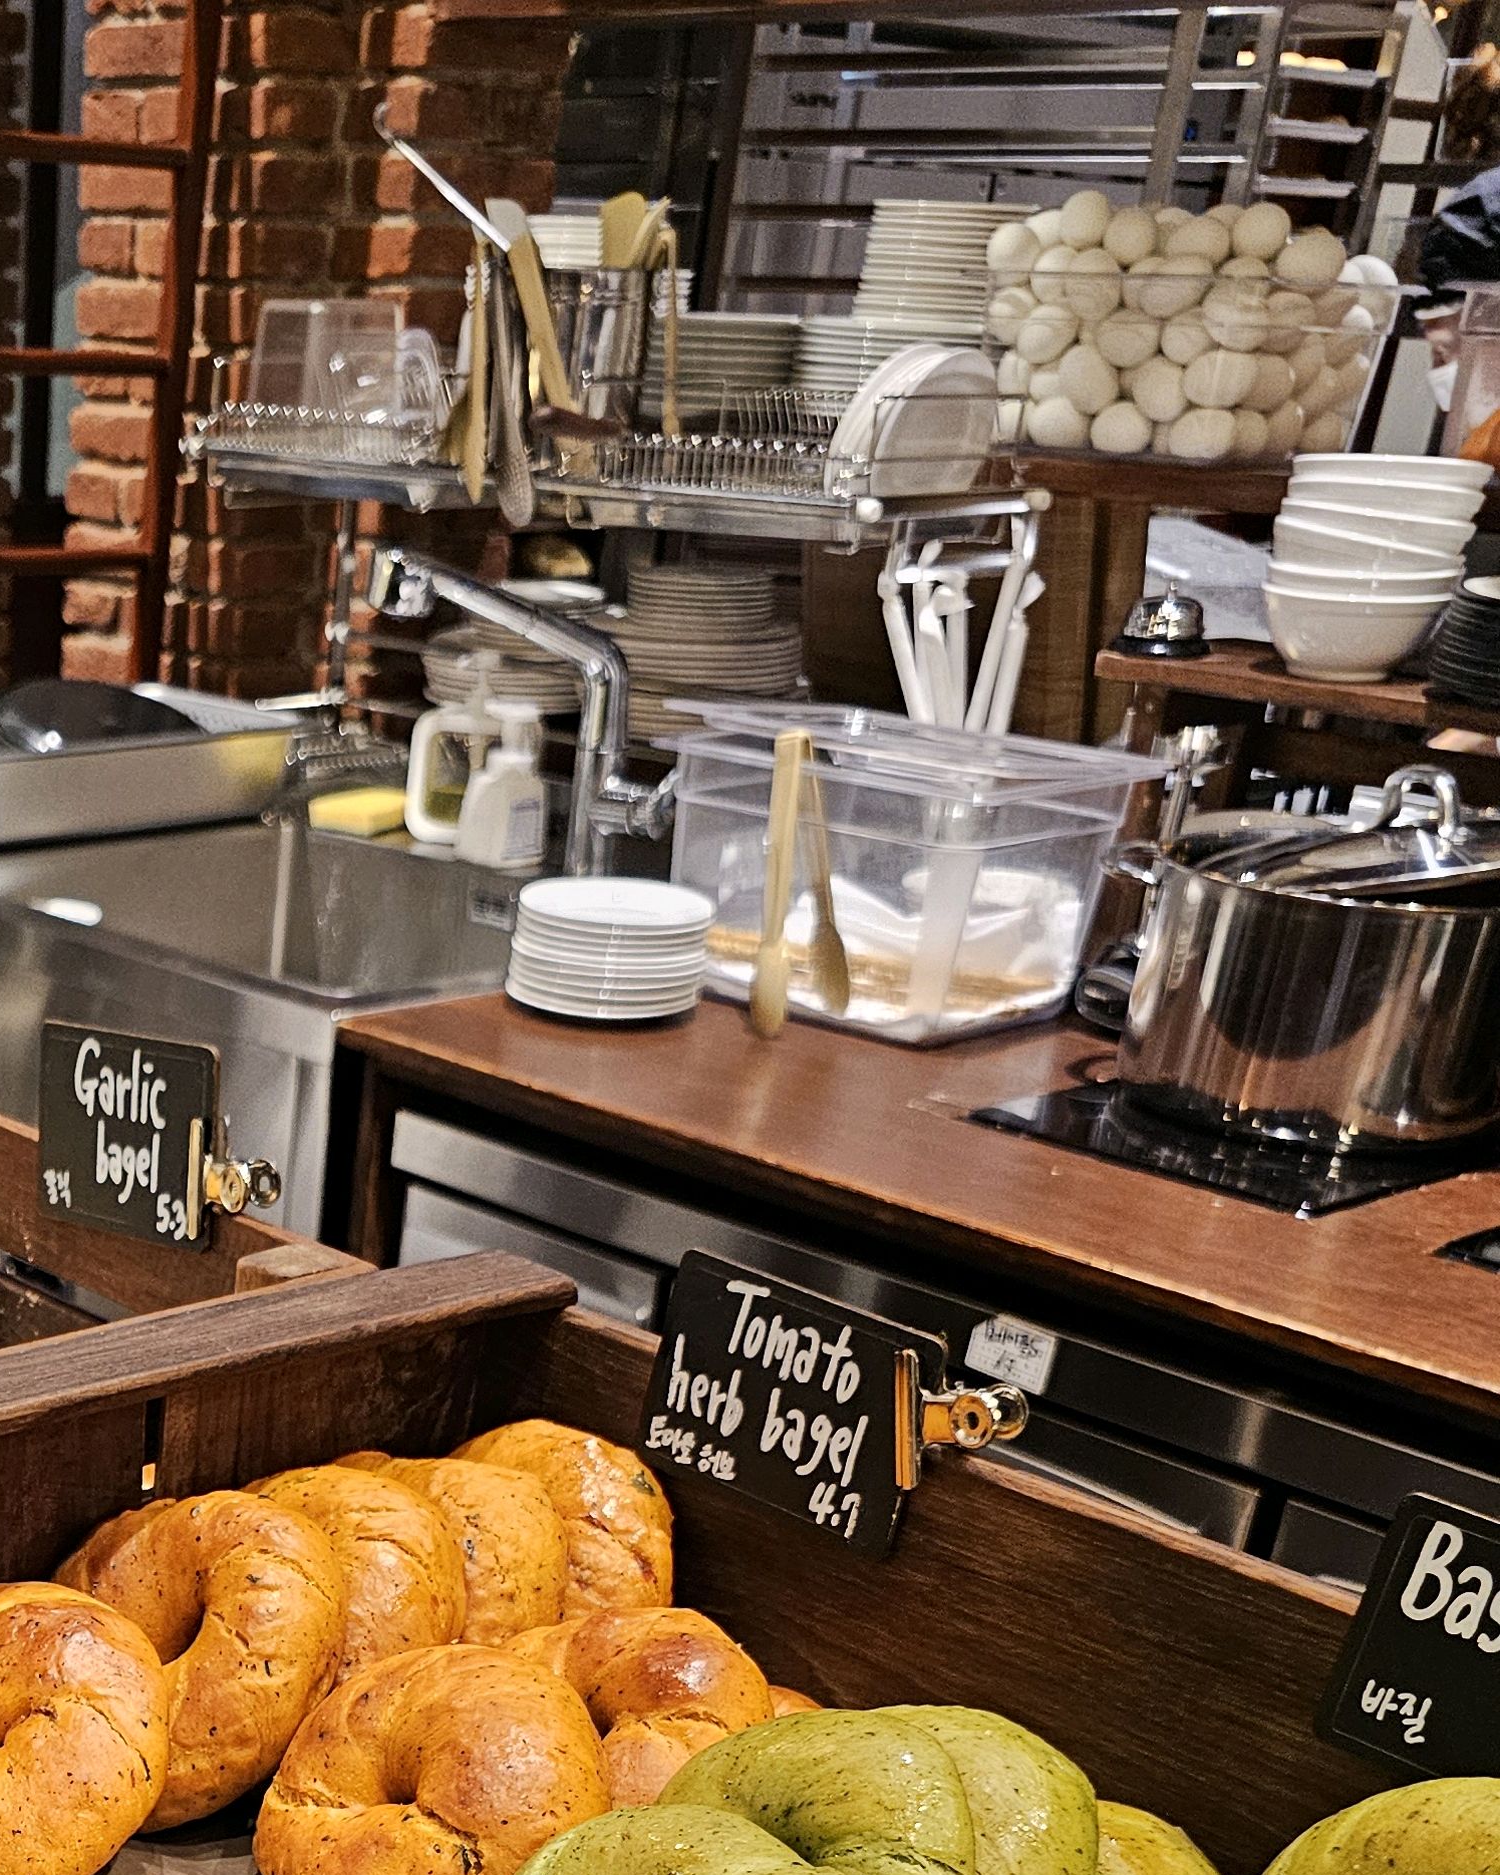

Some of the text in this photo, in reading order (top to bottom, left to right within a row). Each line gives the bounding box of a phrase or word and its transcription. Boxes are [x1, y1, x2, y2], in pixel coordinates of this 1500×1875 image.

[74, 1037, 167, 1130] Garlic
[95, 1119, 161, 1204] bagel
[725, 1279, 861, 1405] Tomato
[666, 1333, 870, 1488] herb bagel
[697, 1443, 738, 1481] 허브
[808, 1482, 861, 1539] 4.7
[1361, 1679, 1432, 1744] 바질
